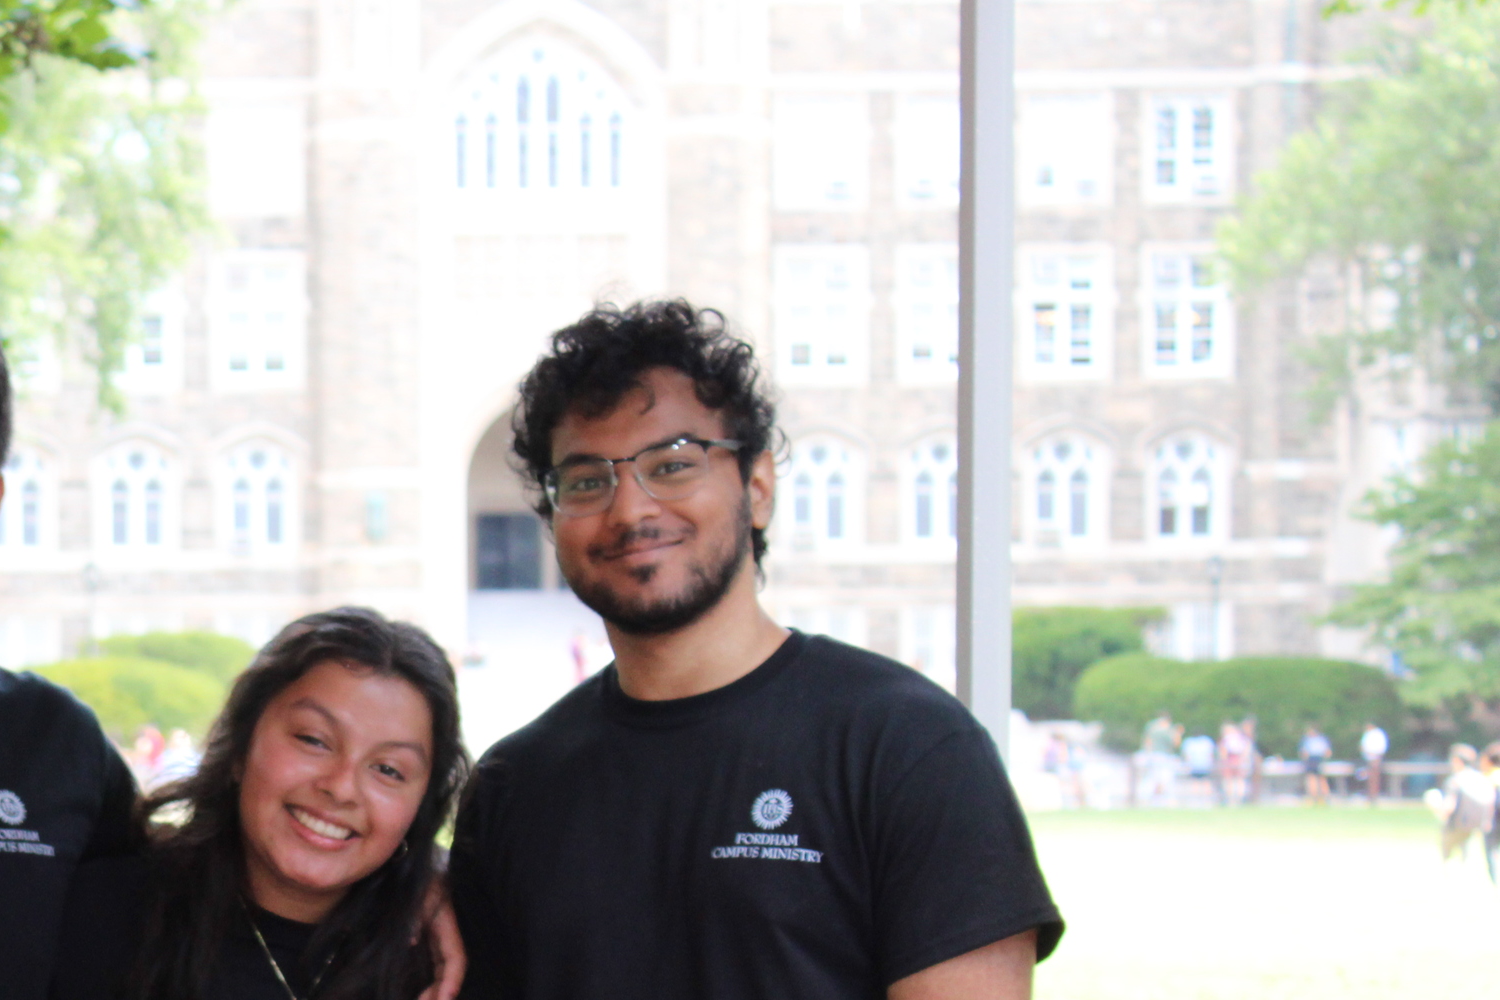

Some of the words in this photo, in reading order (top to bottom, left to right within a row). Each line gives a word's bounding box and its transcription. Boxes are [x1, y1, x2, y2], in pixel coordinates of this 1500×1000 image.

[735, 833, 799, 847] FORDHAM
[711, 846, 760, 859] CAMPUS
[761, 848, 825, 864] MINISTRY
